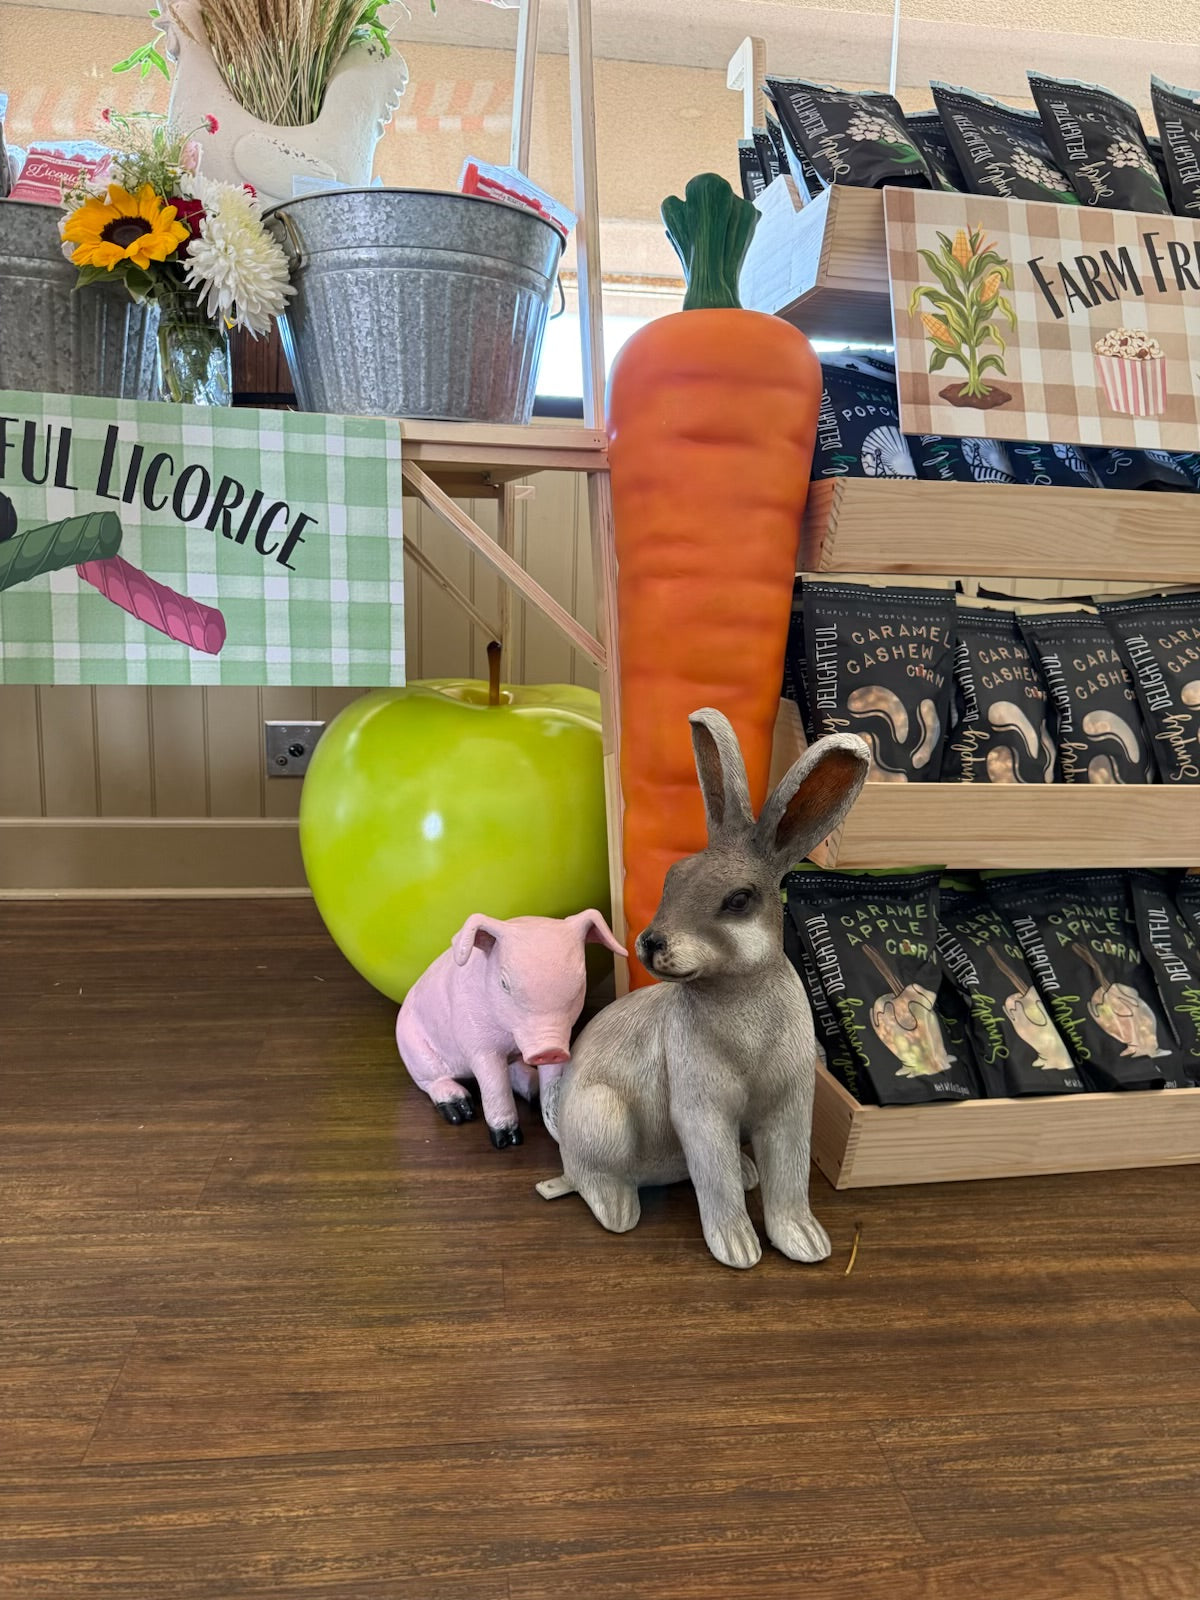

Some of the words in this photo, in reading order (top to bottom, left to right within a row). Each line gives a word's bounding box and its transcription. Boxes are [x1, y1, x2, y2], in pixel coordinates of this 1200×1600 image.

[1050, 101, 1089, 161] DELIGHTFUL
[1165, 118, 1200, 185] DELIGHTFUL
[26, 163, 91, 182] Licoric
[1075, 161, 1114, 205] Simply
[1027, 246, 1144, 319] FARM
[842, 405, 898, 421] POPC
[96, 424, 318, 571] LICORICE
[851, 624, 951, 649] CARAMEL
[978, 647, 1030, 664] CARA
[815, 623, 838, 709] DELIGHTFUL
[846, 643, 934, 675] CASHEW
[1072, 648, 1121, 672] CARA
[1124, 634, 1173, 712] DELIGHTFUL
[1075, 668, 1133, 700] CASHE
[951, 725, 990, 783] imply
[1154, 712, 1199, 781] Simply
[840, 903, 939, 927] CARAMEL
[847, 919, 924, 946] APPLE
[967, 924, 1012, 946] APPL
[1048, 904, 1135, 924] CARAMEL
[1055, 920, 1121, 947] APPLE
[805, 912, 845, 996] DELIGHTFUL
[1012, 915, 1061, 992] DELIGHTFUL
[1148, 907, 1192, 982] DELIGHTFUL
[971, 988, 1009, 1064] Simply
